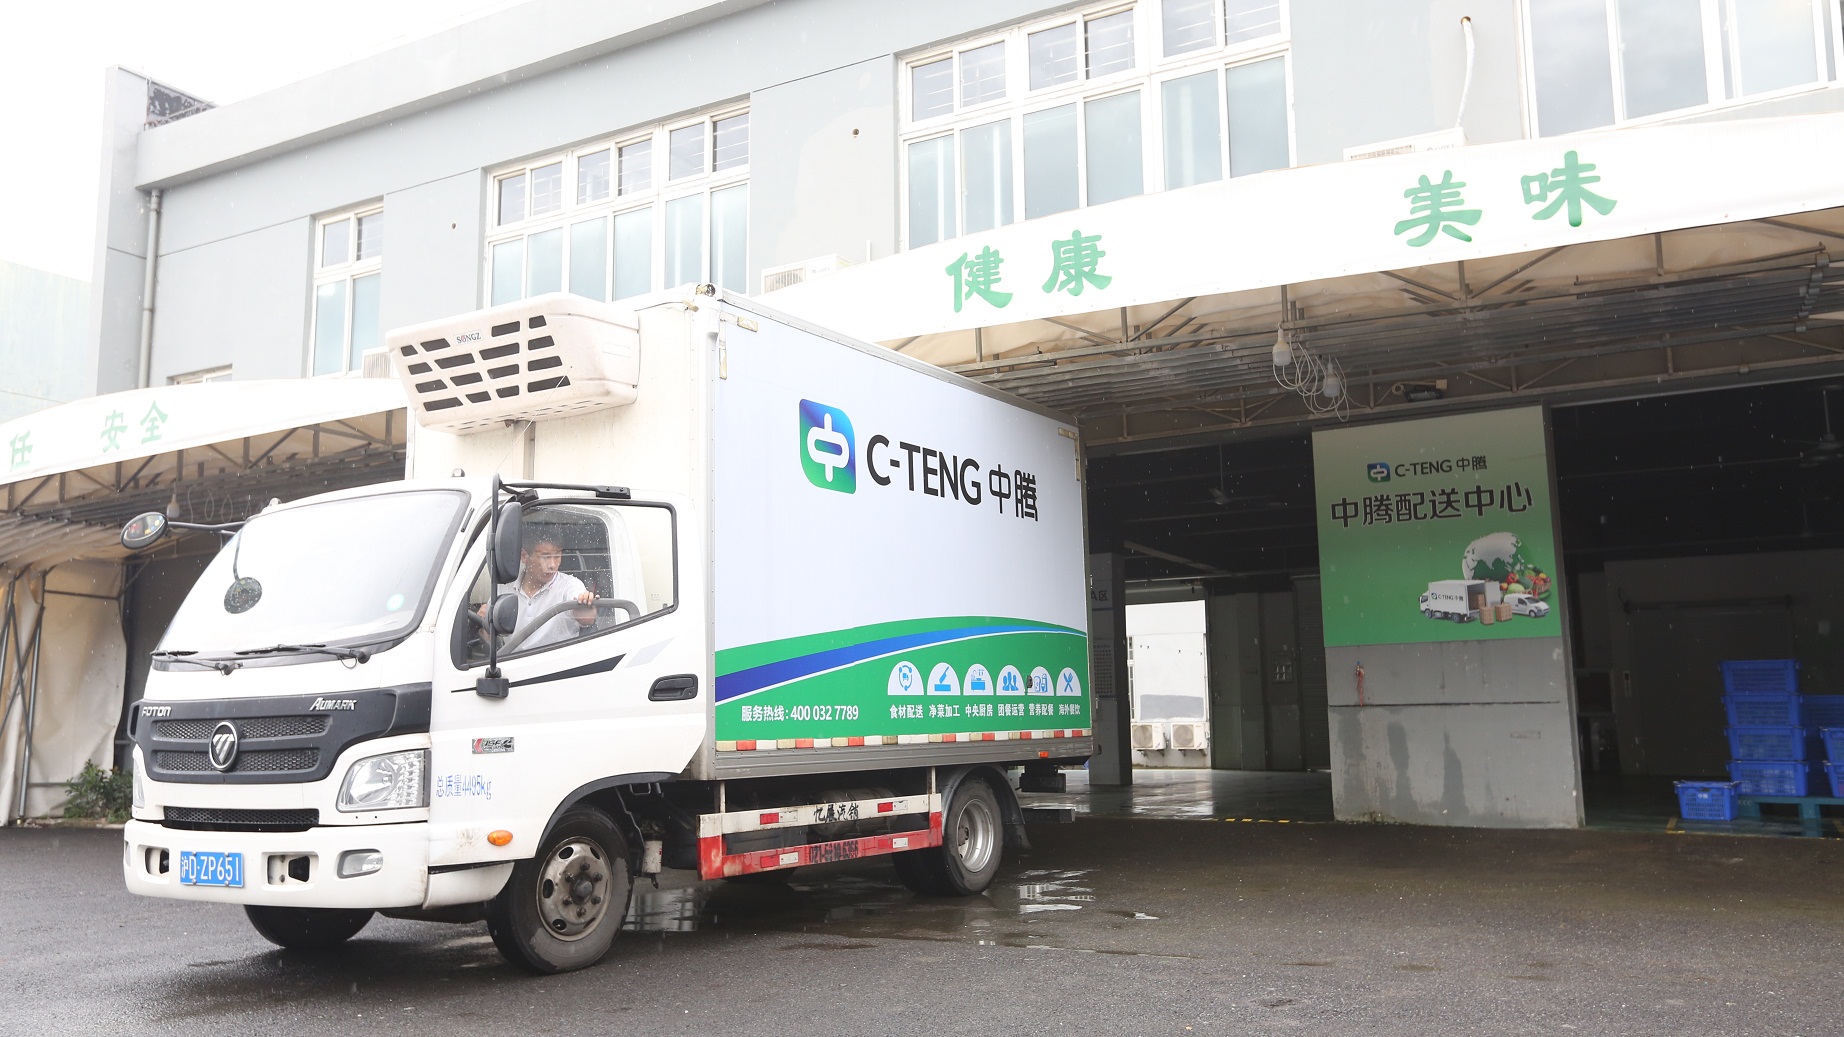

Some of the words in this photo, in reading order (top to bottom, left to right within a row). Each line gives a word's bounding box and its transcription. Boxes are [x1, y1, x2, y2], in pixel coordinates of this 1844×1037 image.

[946, 229, 1112, 313] 健康
[1394, 150, 1618, 247] 美味
[456, 332, 482, 344] SONGZ
[9, 430, 33, 471] 任
[101, 401, 169, 453] 安全
[1394, 459, 1453, 478] C-TENG
[1456, 455, 1488, 472] 中腾
[866, 434, 982, 506] C-TENG
[988, 463, 1039, 522] 中腾
[1330, 482, 1533, 528] 中腾配送中心
[141, 705, 172, 717] FOTON
[309, 697, 358, 711] AUMARK
[790, 705, 811, 721] 400
[813, 705, 832, 721] 032
[834, 705, 859, 720] 7789
[889, 704, 924, 718] 食材配送
[928, 704, 961, 718] 净菜加工
[965, 704, 994, 717] 中央厨房
[997, 703, 1025, 716] 团餐运营
[1028, 703, 1054, 716] 营养配餐
[1058, 704, 1081, 716] 海外餐饮
